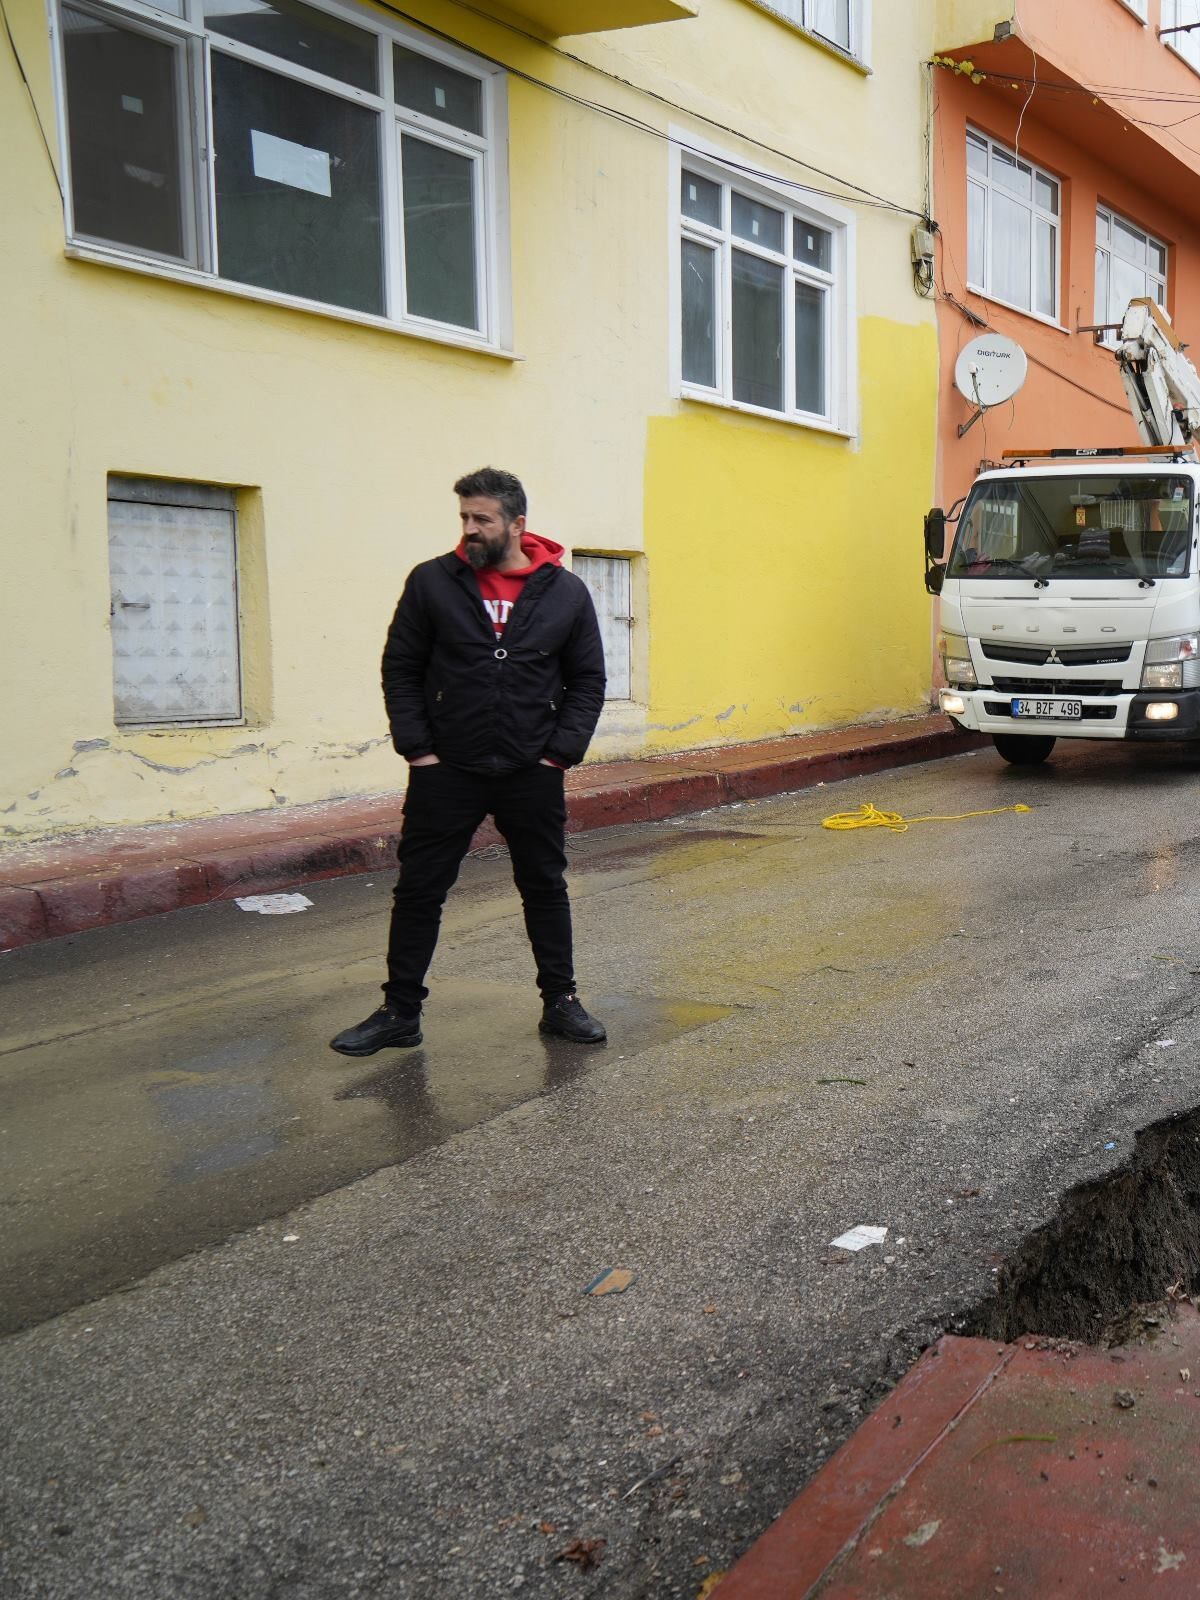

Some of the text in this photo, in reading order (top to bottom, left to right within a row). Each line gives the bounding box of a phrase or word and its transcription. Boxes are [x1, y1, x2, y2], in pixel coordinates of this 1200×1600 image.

[977, 349, 1011, 359] DIGITURK
[991, 624, 1117, 633] FUSO
[1018, 701, 1080, 716] 34 BZF 496
